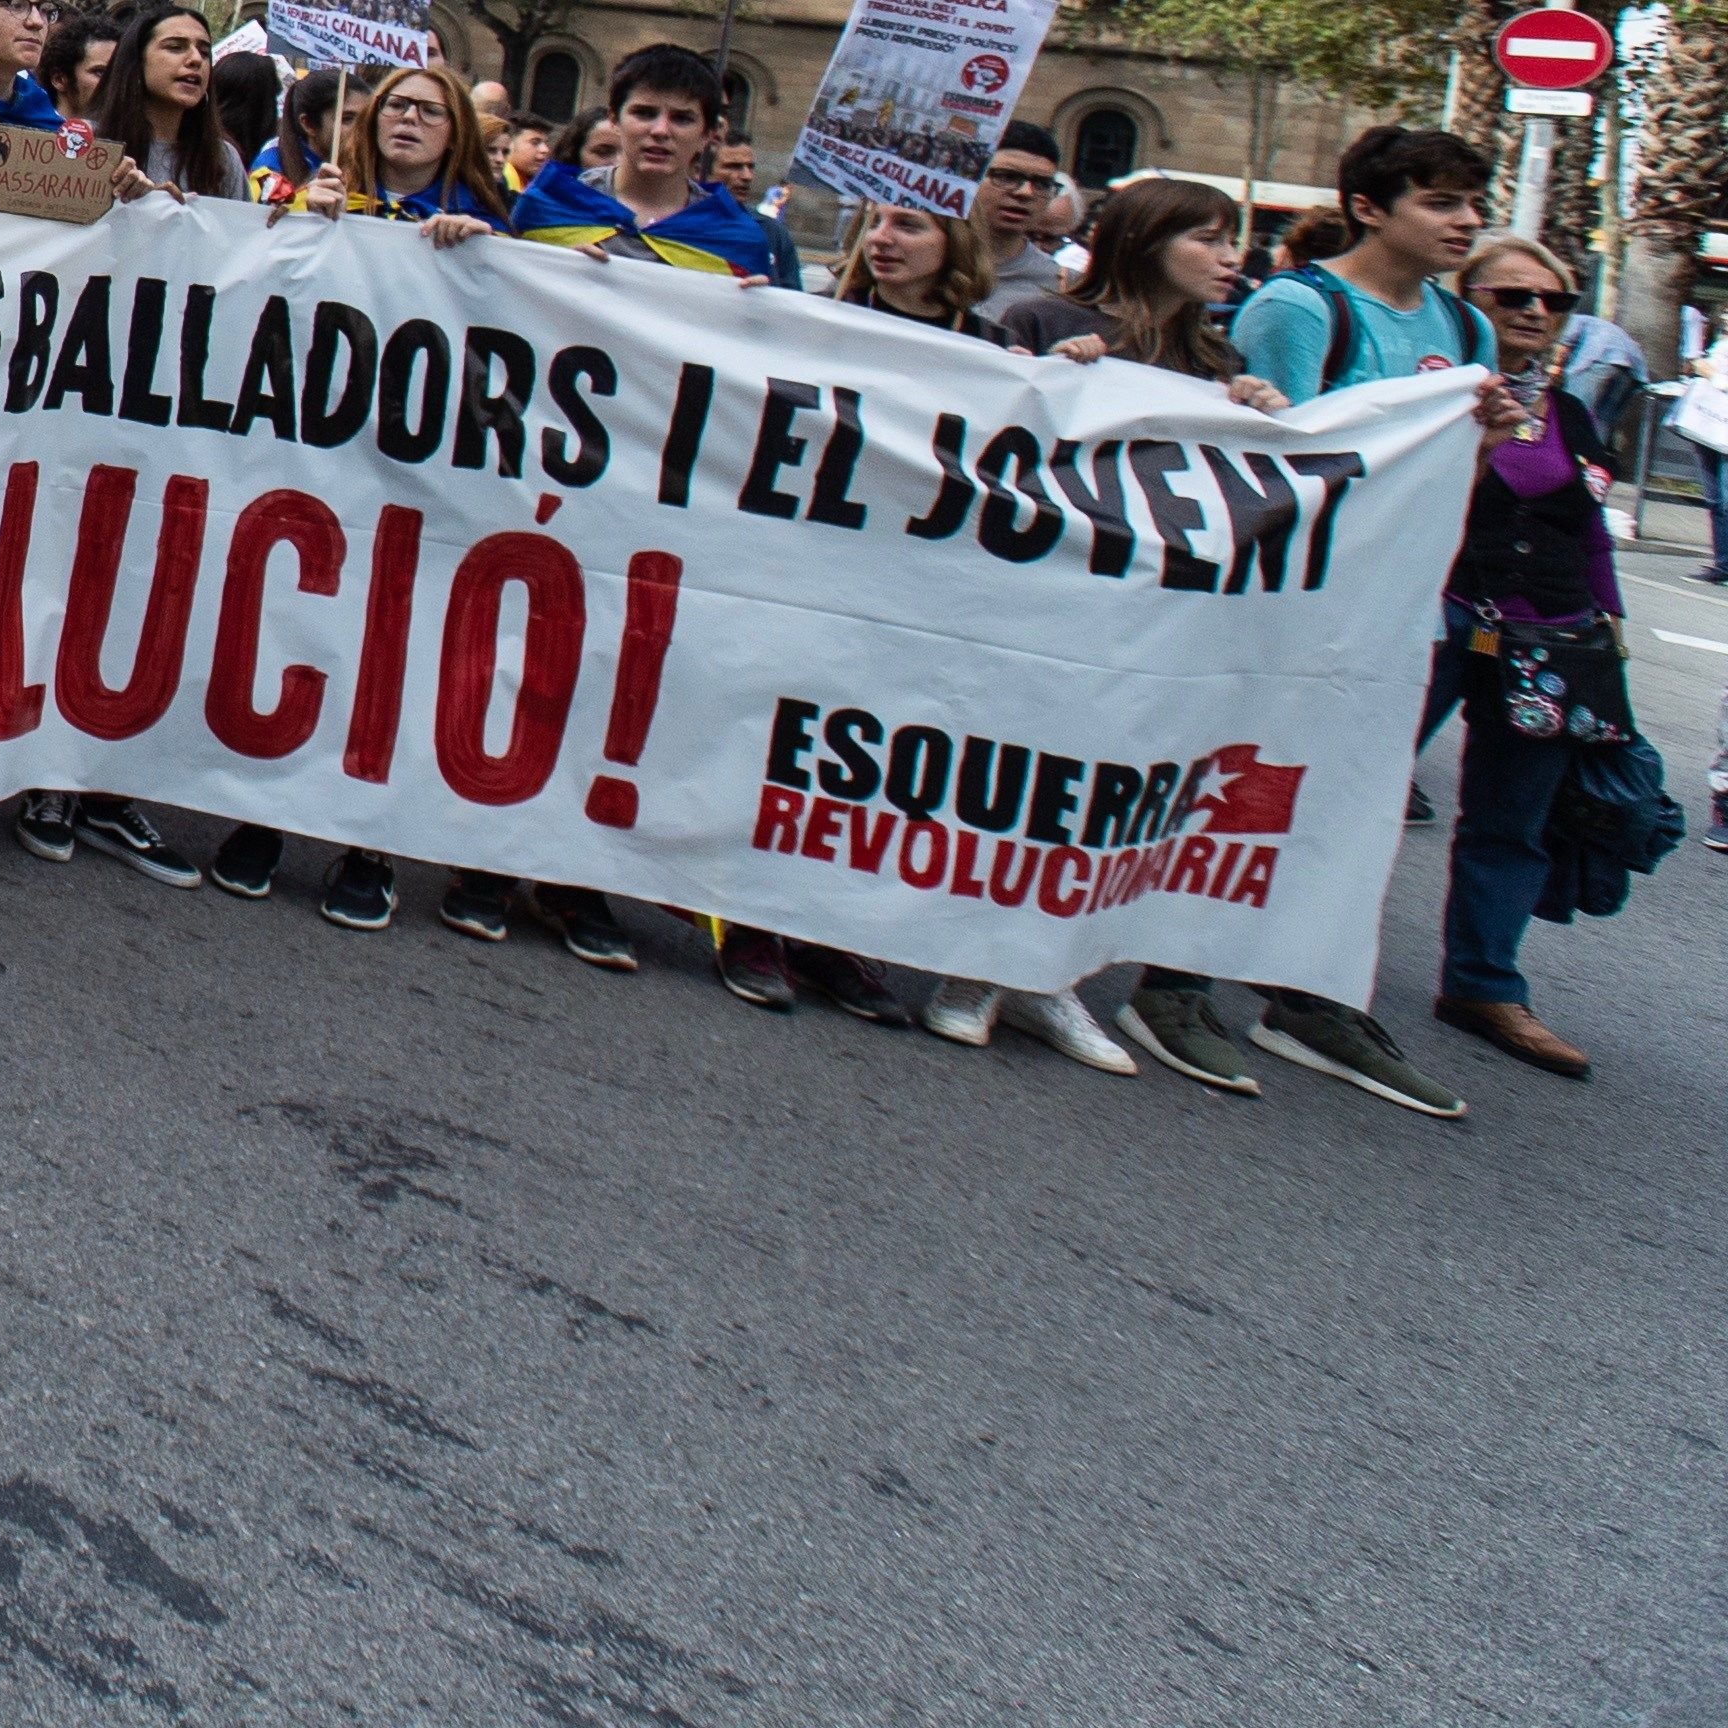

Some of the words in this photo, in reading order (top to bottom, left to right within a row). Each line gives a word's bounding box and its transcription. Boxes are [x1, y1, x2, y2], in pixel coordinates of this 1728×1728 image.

[332, 18, 425, 69] CATALANA
[22, 139, 55, 164] NO
[872, 157, 966, 218] CATALANA
[656, 362, 714, 508] I
[737, 375, 870, 531] EL
[905, 413, 1368, 596] JOVENT
[764, 696, 1206, 848] ESQUERRA
[751, 783, 1280, 919] REVOLUCIONARIA
